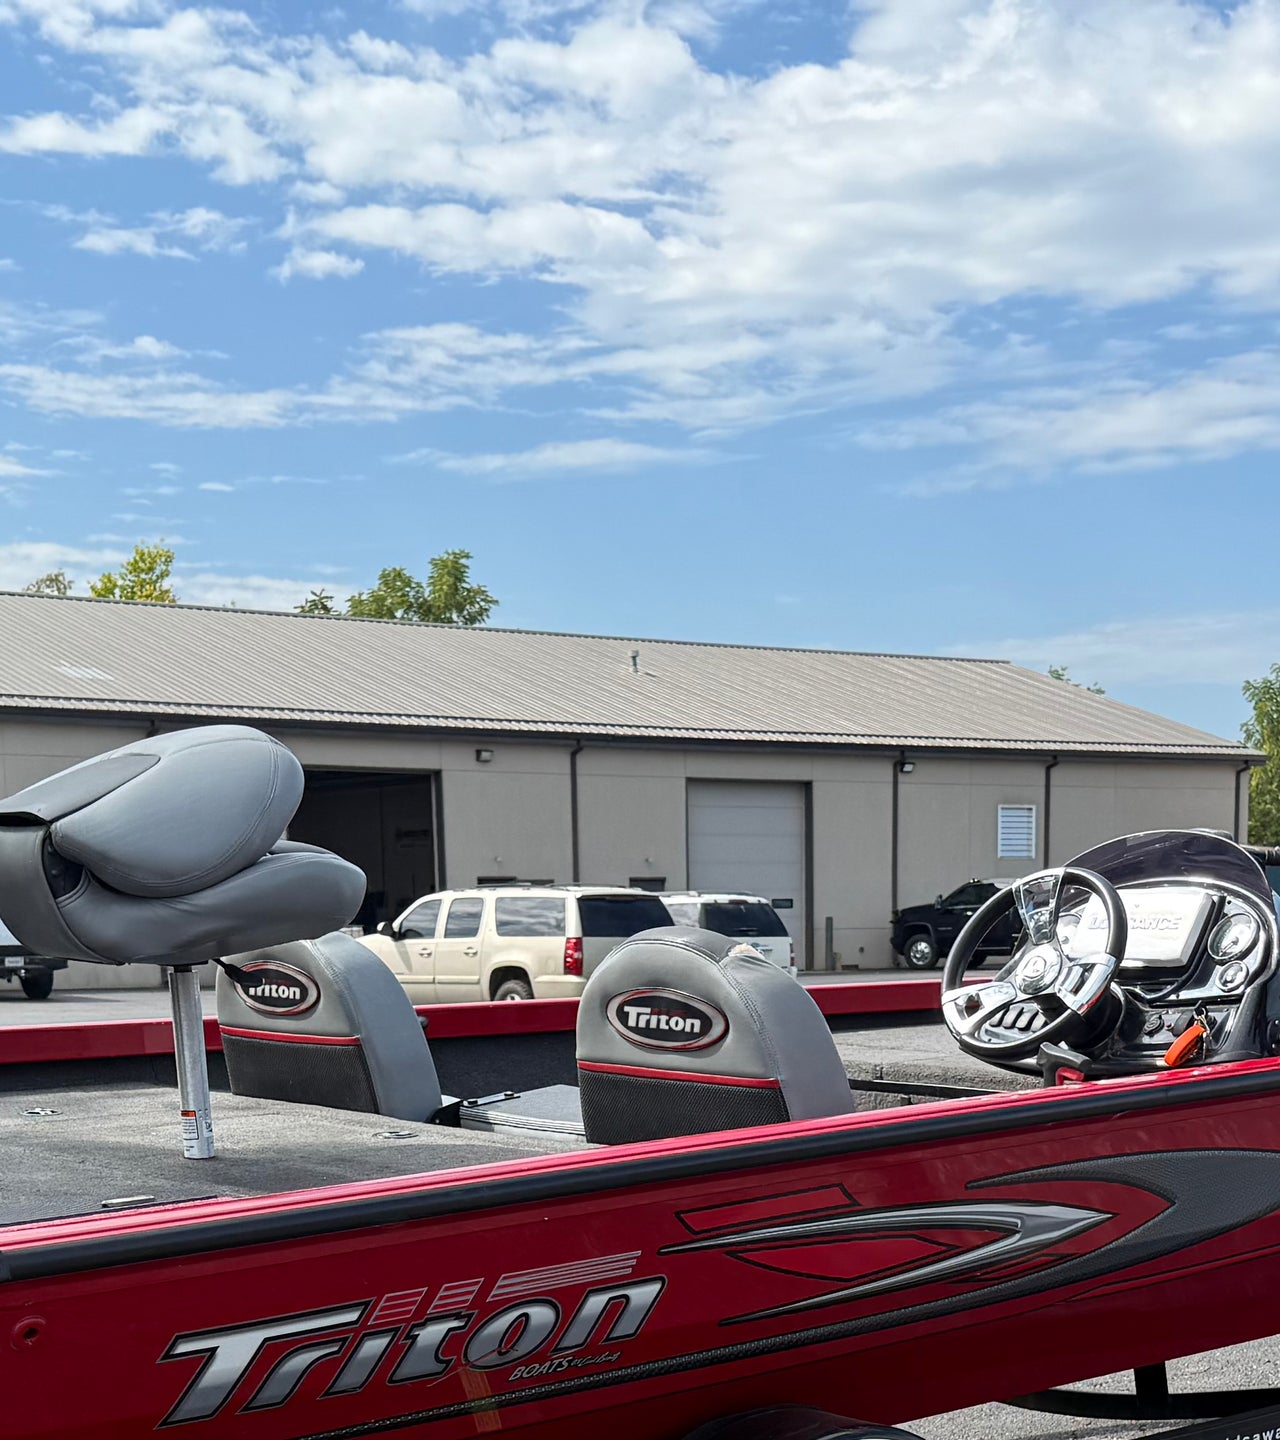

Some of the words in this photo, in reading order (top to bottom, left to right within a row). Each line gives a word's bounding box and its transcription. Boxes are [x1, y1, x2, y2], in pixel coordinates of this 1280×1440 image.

[623, 1006, 701, 1033] Triton
[155, 1274, 668, 1431] Triton
[507, 1356, 574, 1381] BOATS
